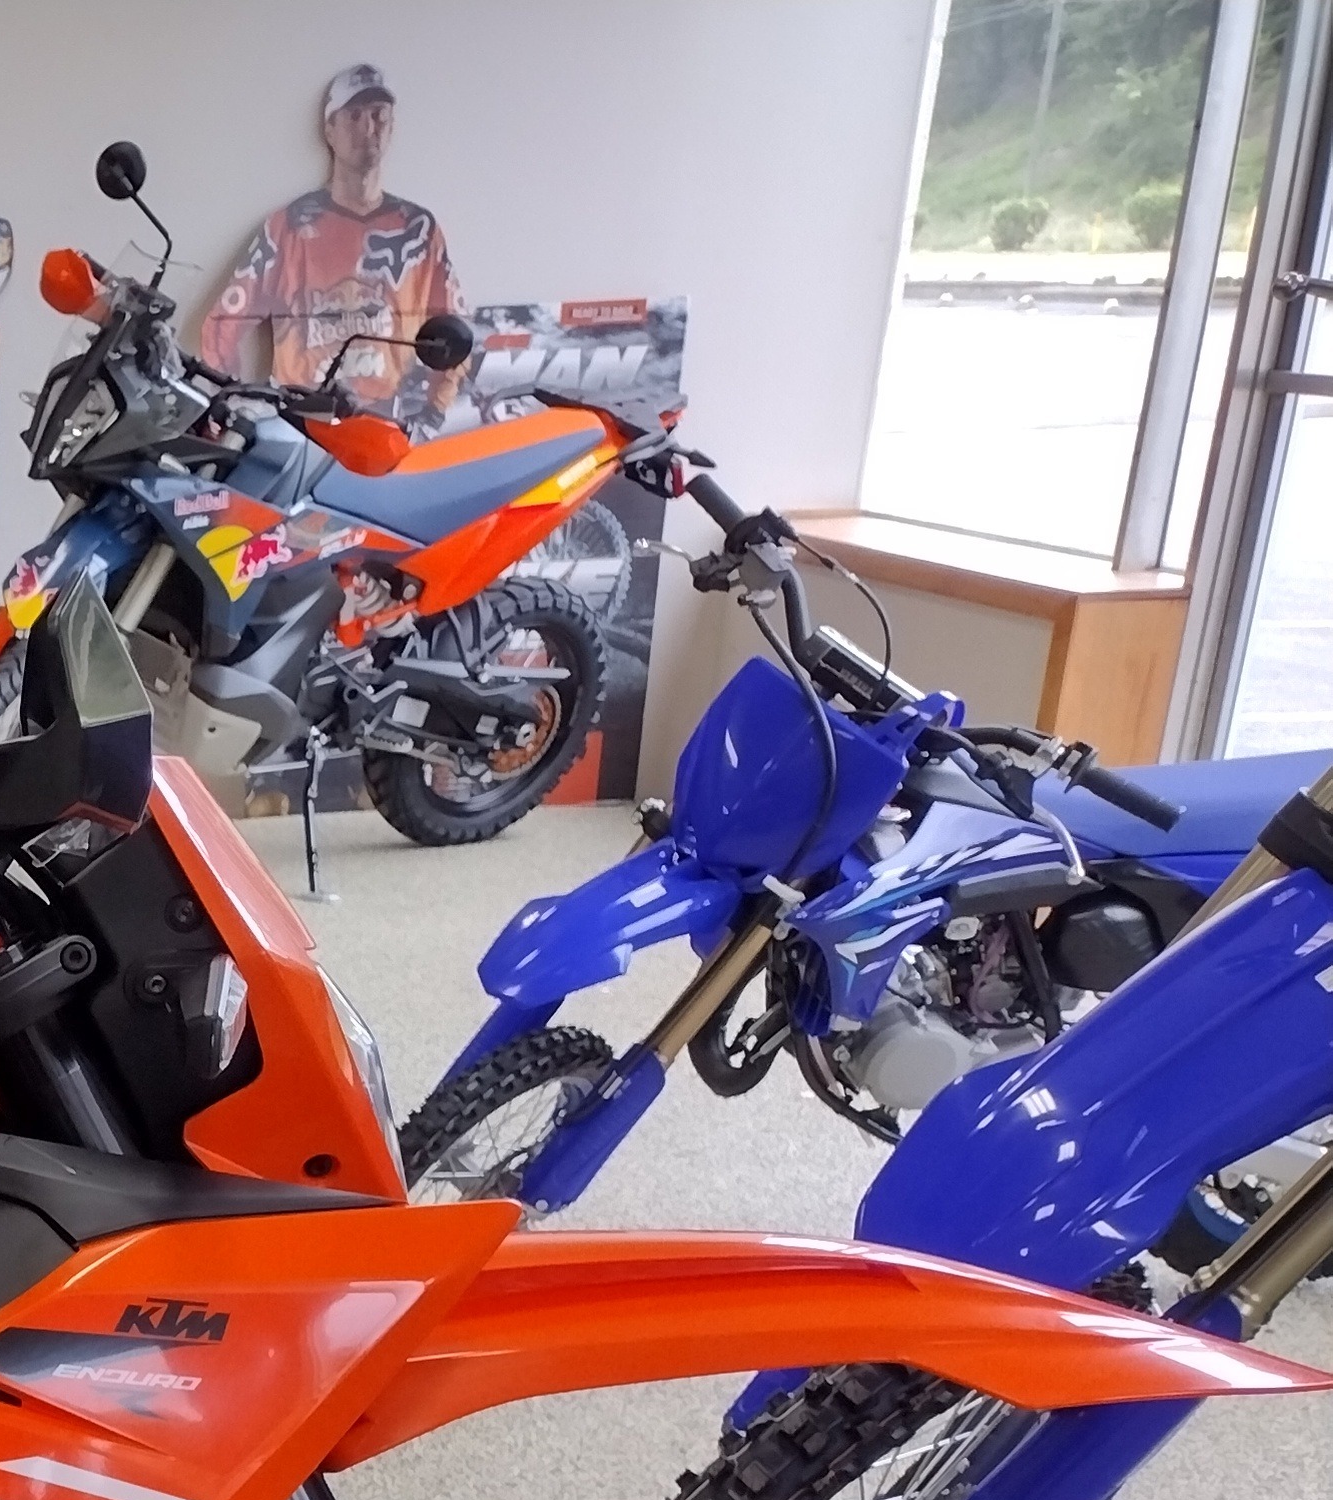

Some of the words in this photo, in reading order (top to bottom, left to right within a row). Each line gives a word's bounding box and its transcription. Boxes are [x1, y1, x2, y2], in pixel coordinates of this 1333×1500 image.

[474, 343, 650, 391] MAN
[114, 1297, 231, 1341] KTM
[51, 1363, 202, 1391] ENDURO
